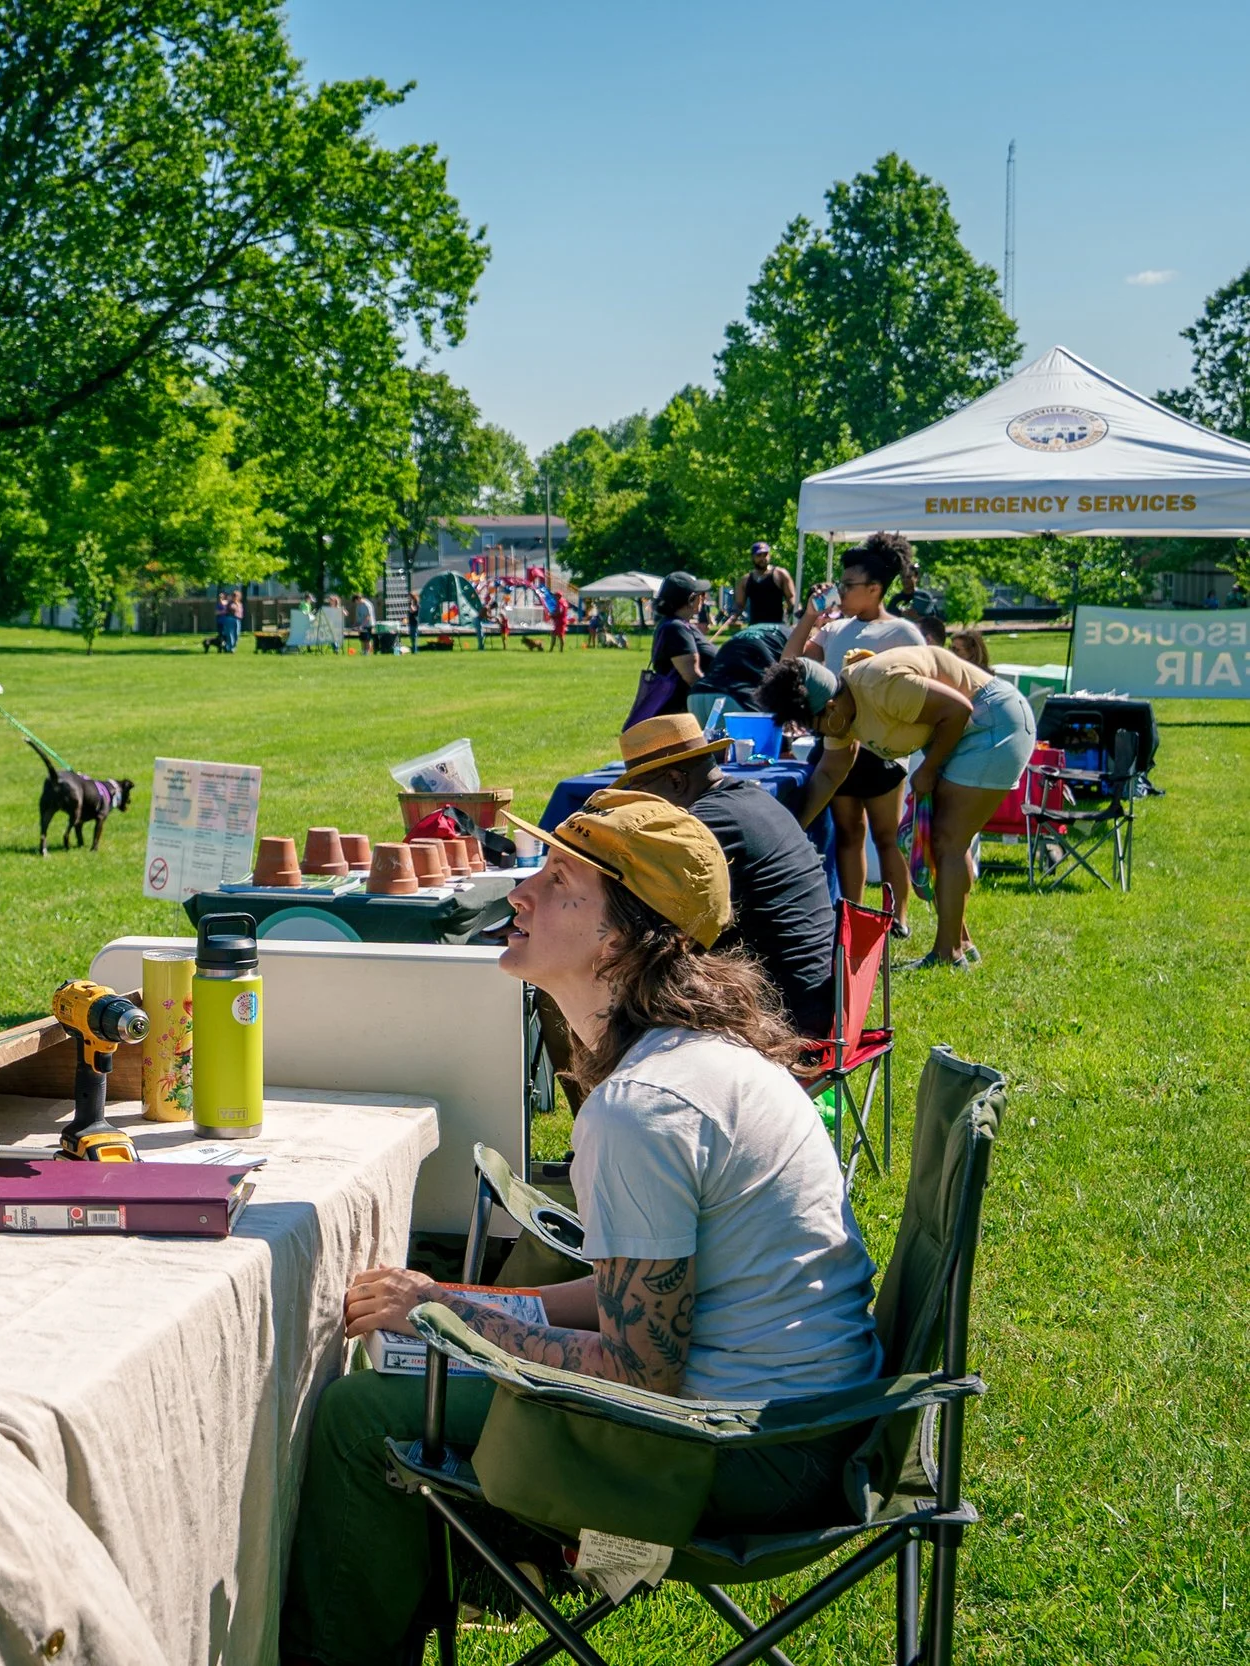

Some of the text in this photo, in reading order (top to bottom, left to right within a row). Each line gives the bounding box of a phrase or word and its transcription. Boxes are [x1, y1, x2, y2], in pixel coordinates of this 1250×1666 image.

[925, 494, 1197, 514] EMERGENCY SERVICES
[221, 1110, 246, 1119] YETI
